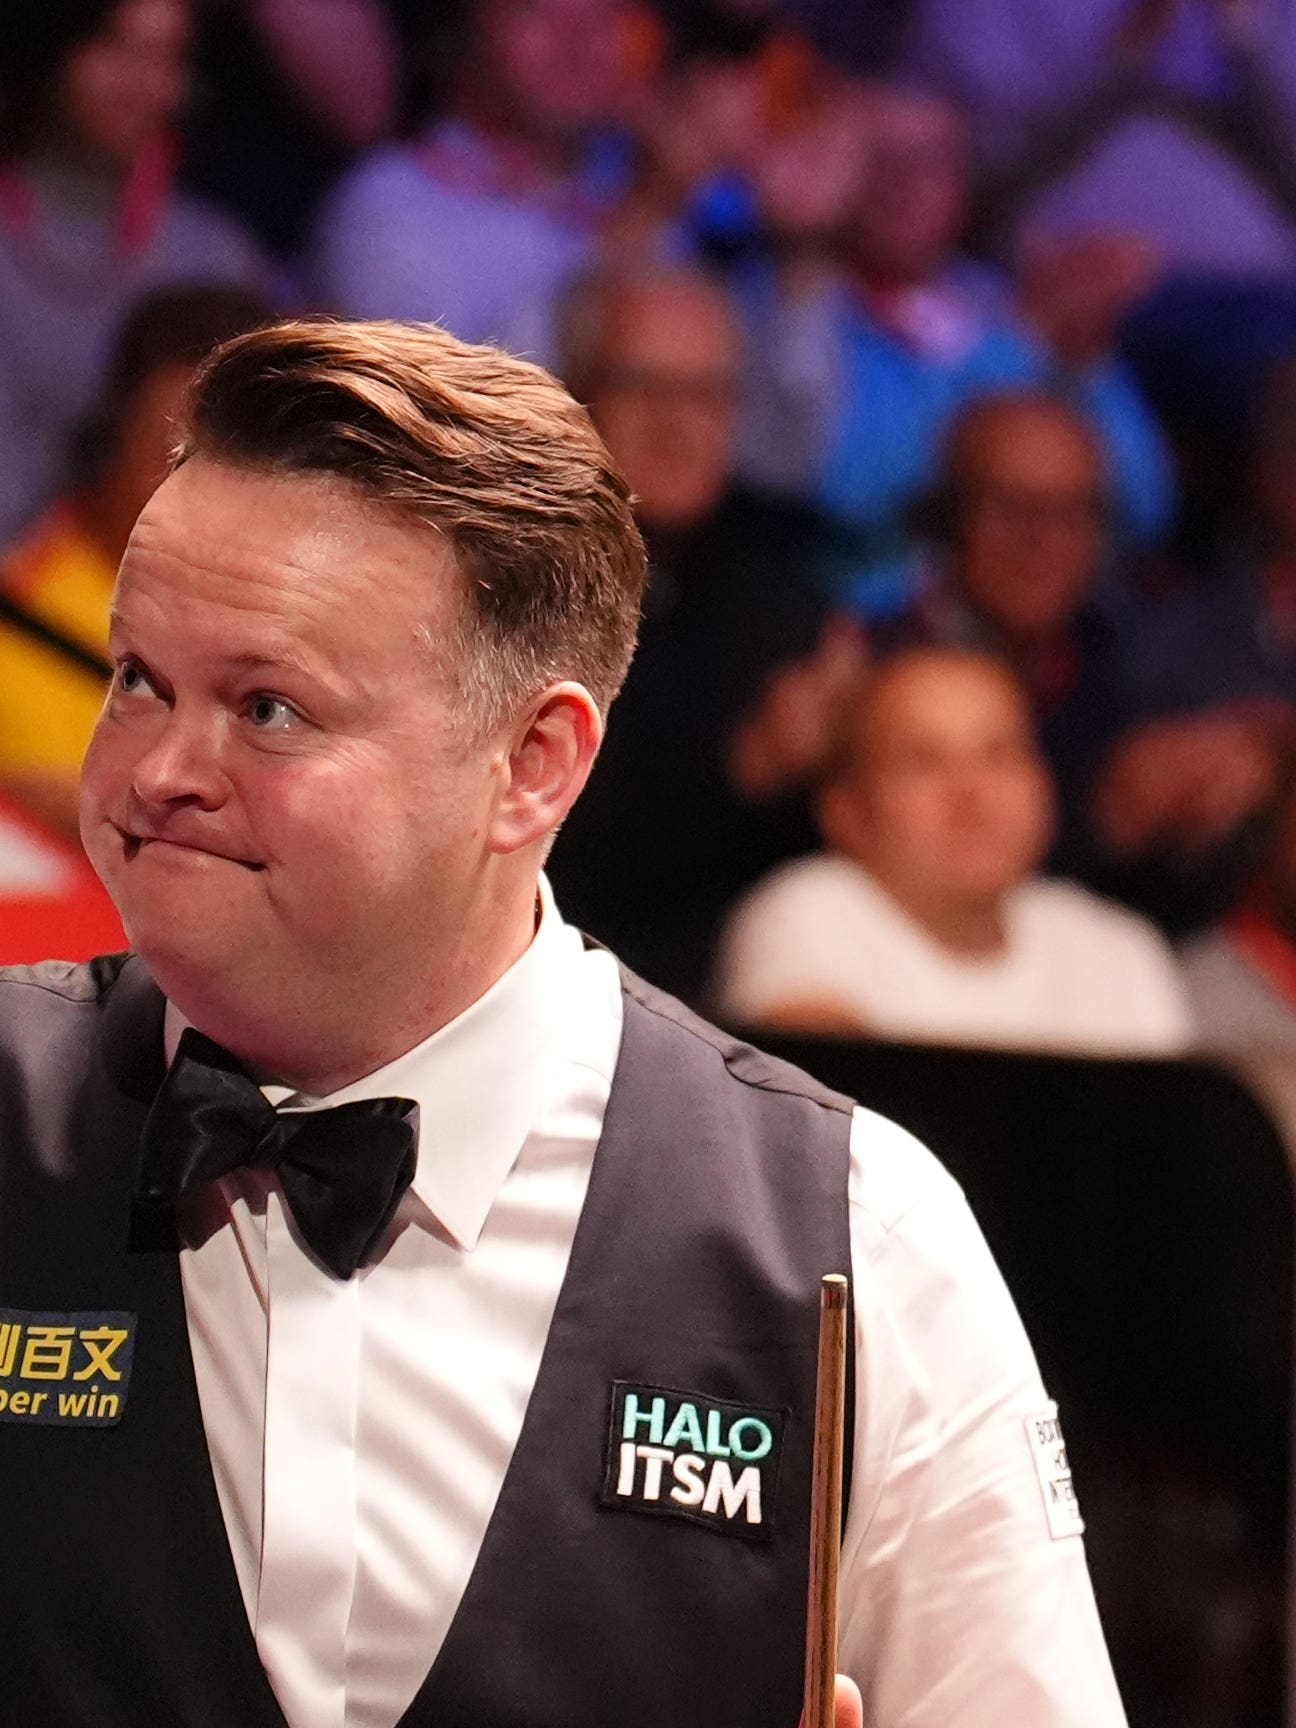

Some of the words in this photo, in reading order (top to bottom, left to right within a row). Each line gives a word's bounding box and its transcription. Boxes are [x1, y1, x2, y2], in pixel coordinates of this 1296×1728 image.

[58, 1384, 120, 1418] win
[622, 1393, 773, 1461] HALO
[616, 1442, 763, 1525] ITSM
